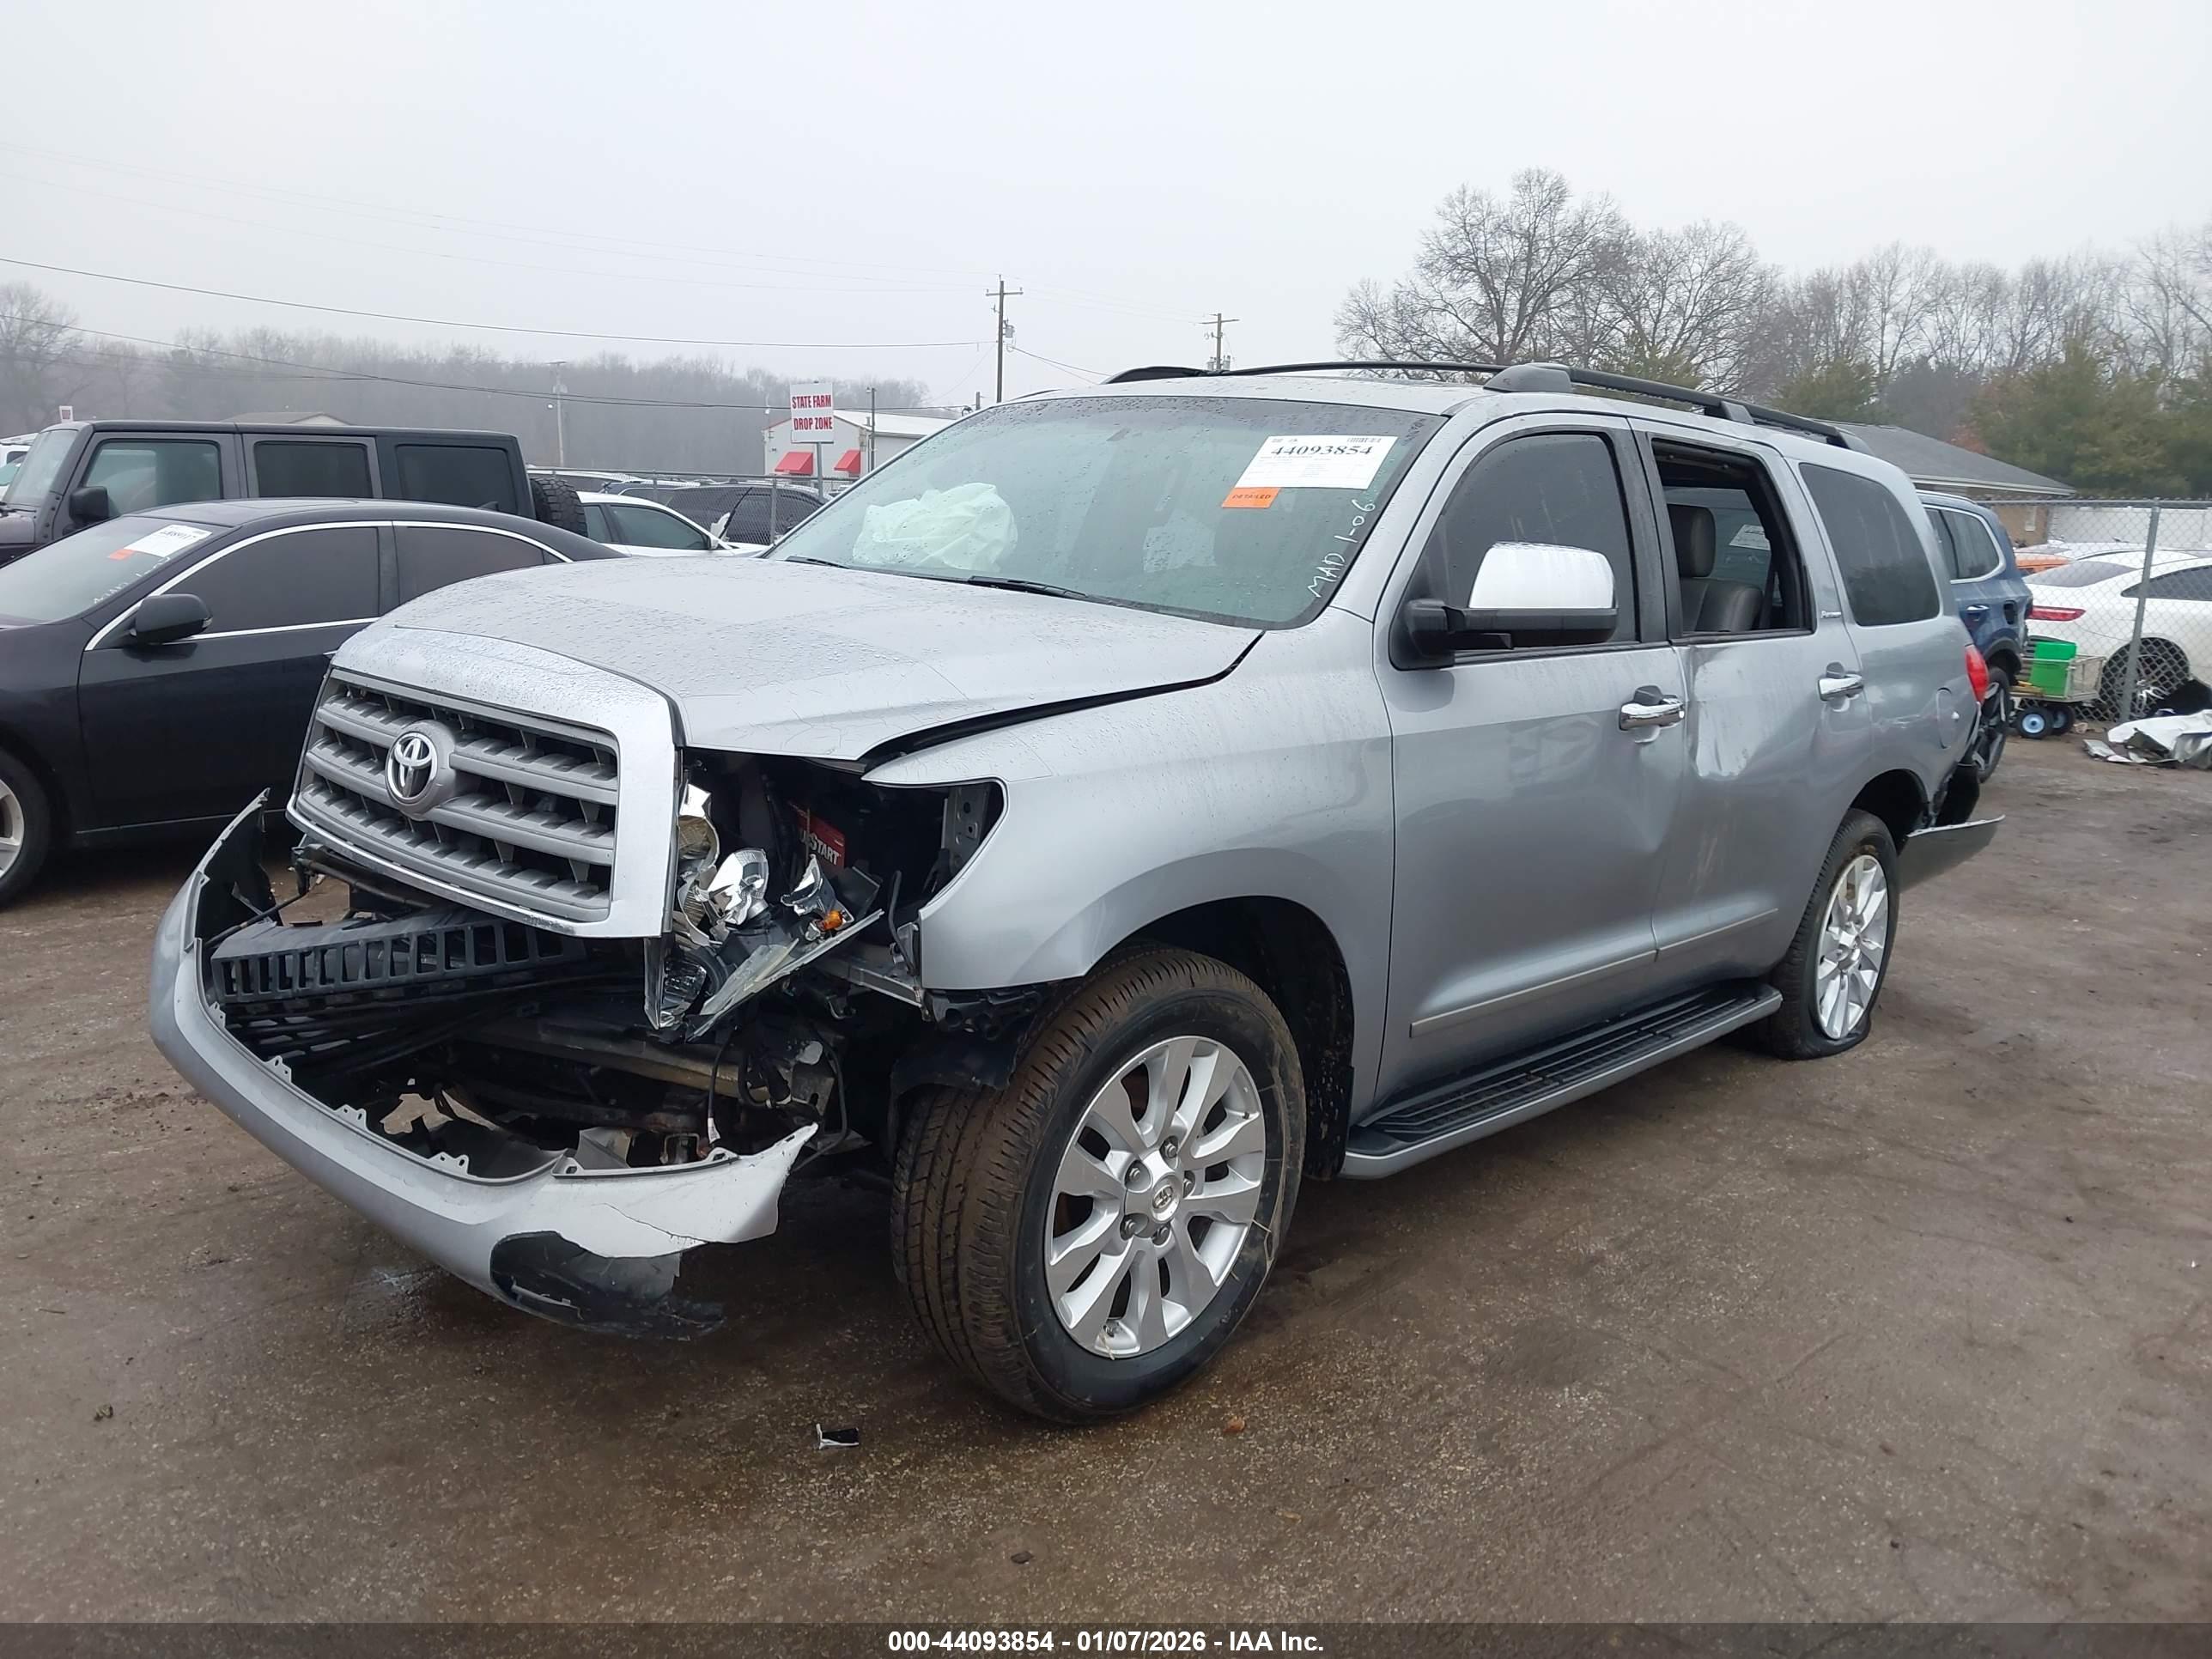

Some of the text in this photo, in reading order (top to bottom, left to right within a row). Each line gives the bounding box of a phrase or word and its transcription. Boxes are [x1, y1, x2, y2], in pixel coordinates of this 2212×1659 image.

[792, 394, 832, 409] STATE FARM
[793, 416, 833, 430] DROP ZONE
[1271, 445, 1374, 455] 44093854
[1307, 499, 1376, 598] MAD 1-06
